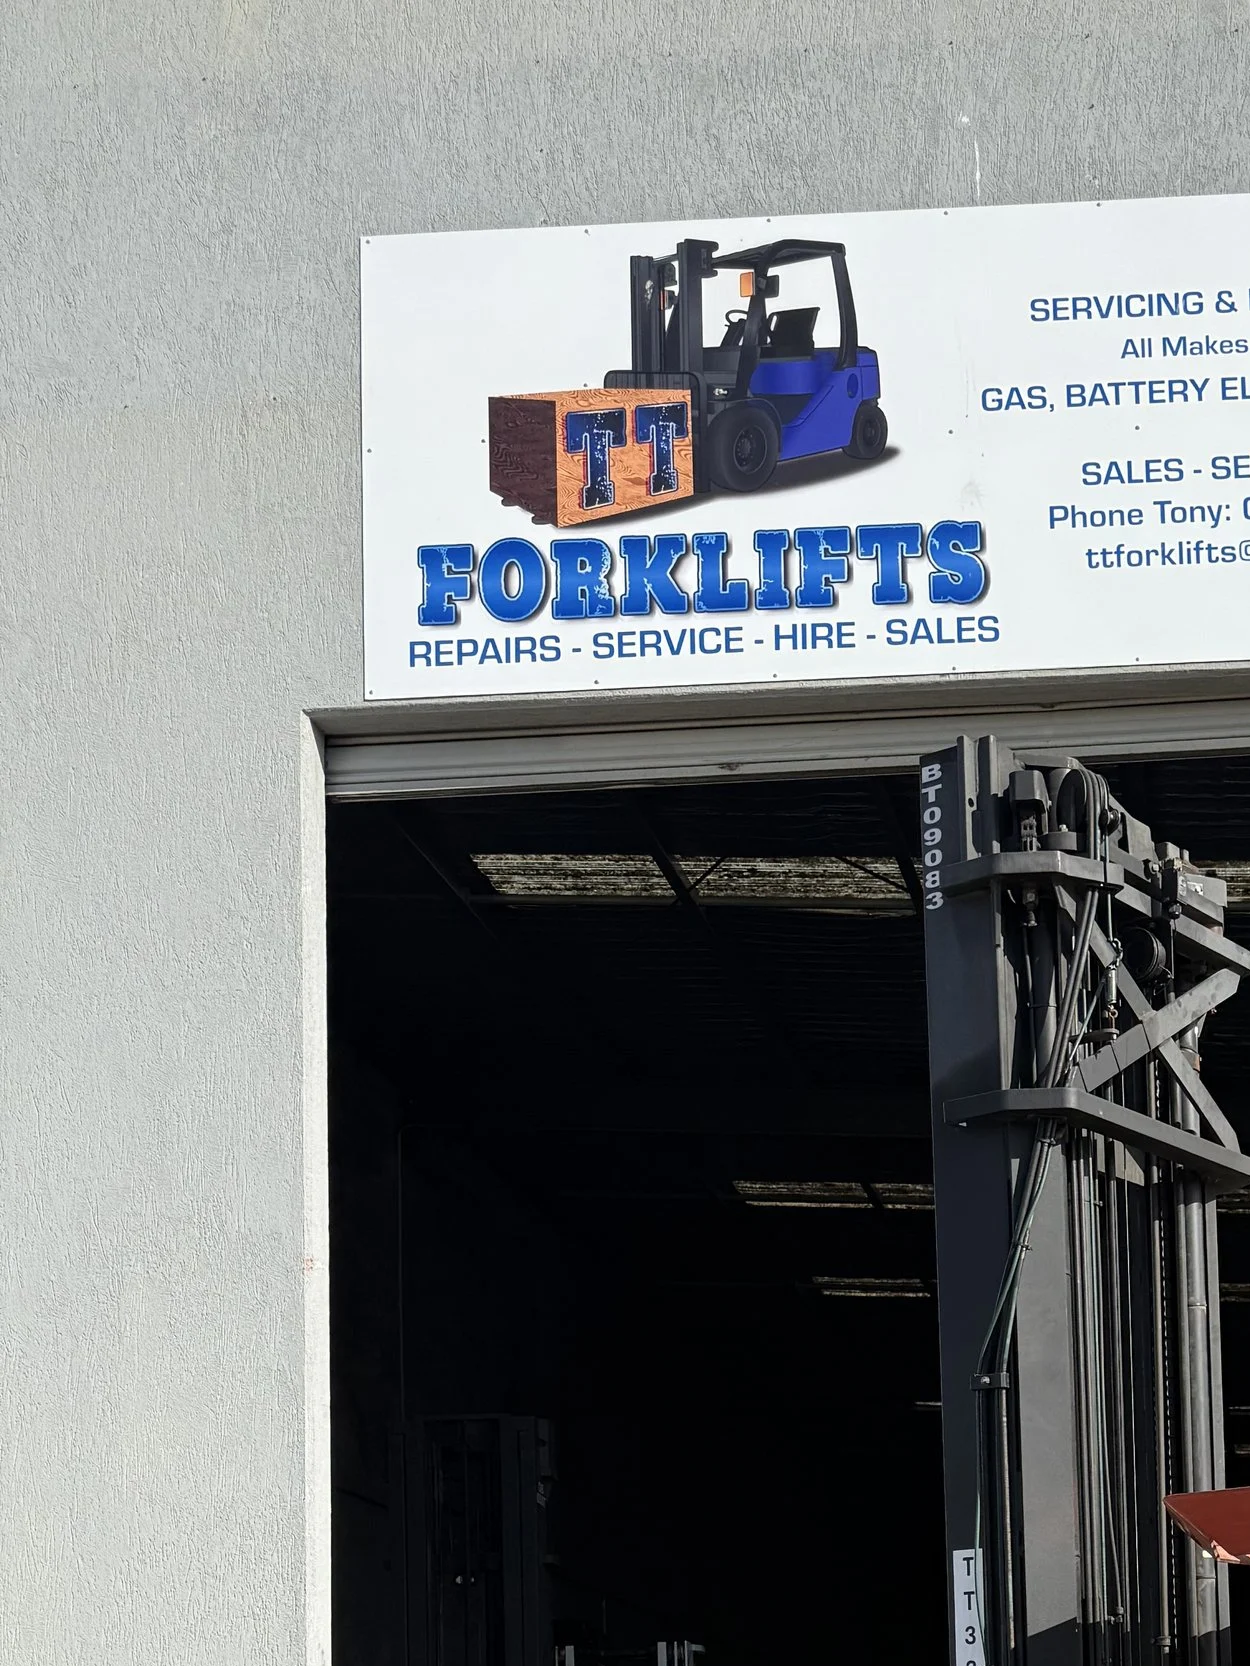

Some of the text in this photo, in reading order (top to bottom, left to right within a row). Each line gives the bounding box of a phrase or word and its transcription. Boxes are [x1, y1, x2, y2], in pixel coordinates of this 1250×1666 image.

[1030, 291, 1204, 322] SERVICING
[1215, 290, 1237, 314] &
[1121, 337, 1152, 359] All
[1161, 335, 1249, 357] Makes
[981, 385, 1054, 412] GAS,
[1066, 378, 1209, 408] BATTERY
[1081, 458, 1184, 486] SALES
[1049, 505, 1144, 529] Phone
[1153, 500, 1230, 527] Tony:
[415, 521, 990, 627] FORKLIFTS
[409, 635, 561, 668] REPAIRS
[592, 626, 744, 660] SERVICE
[774, 621, 856, 651] HIRE
[885, 615, 1000, 646] SALES
[921, 763, 944, 910] BT09083
